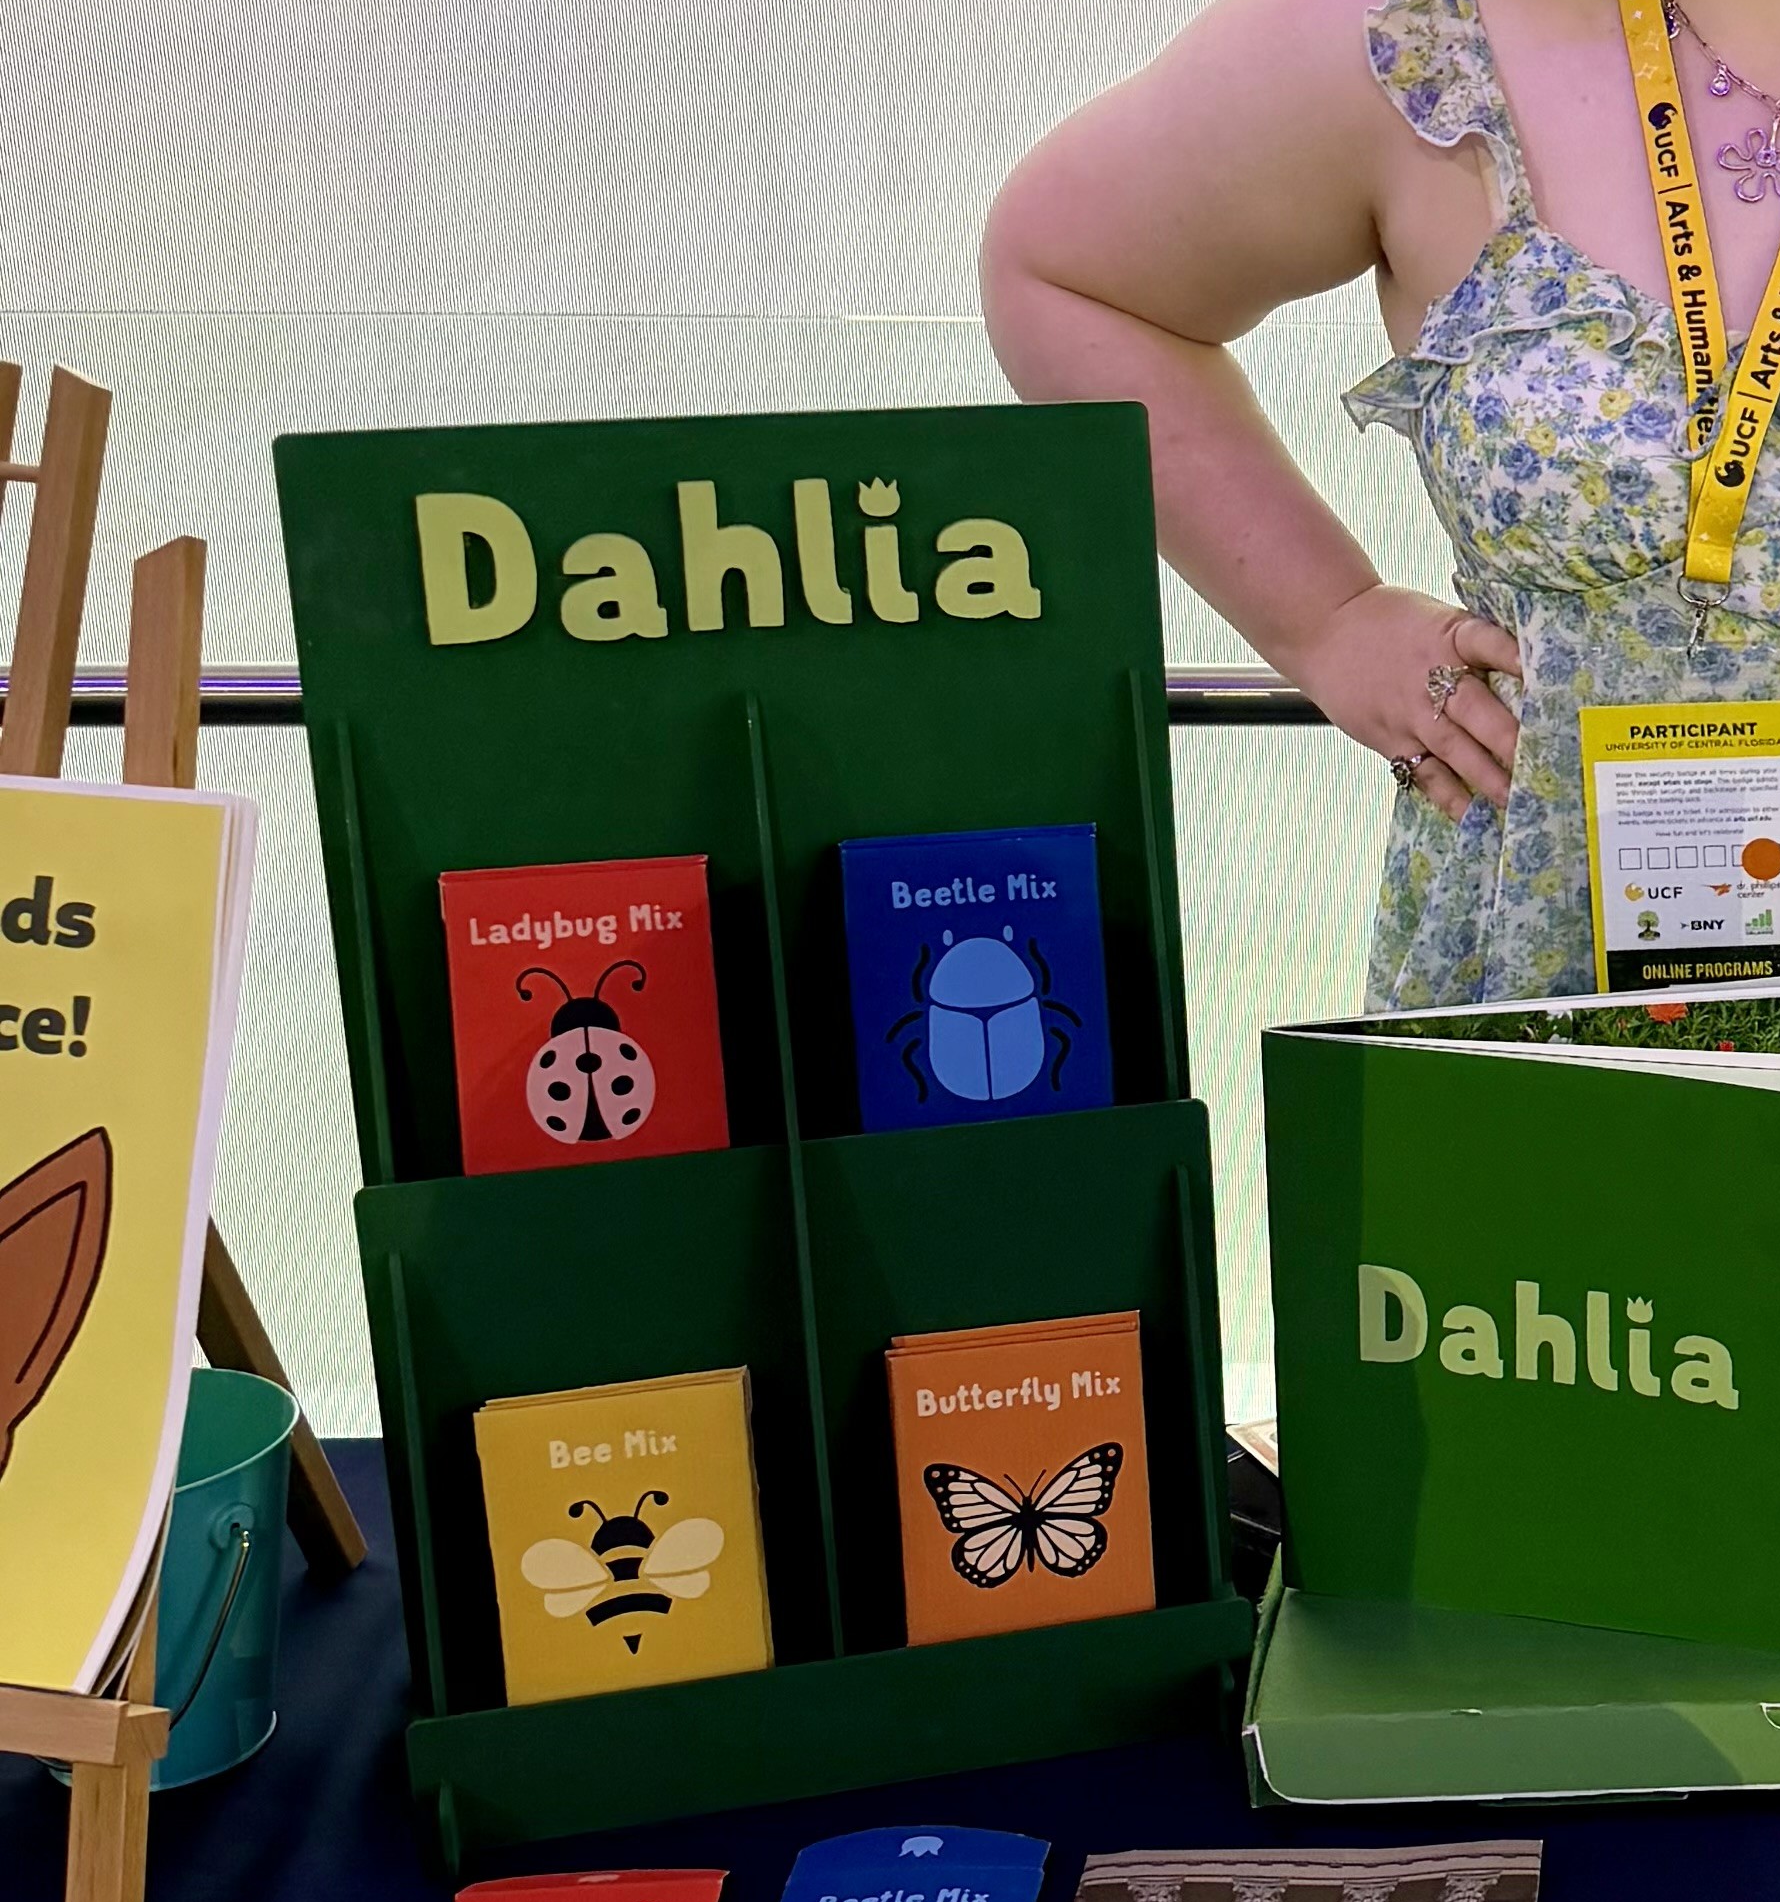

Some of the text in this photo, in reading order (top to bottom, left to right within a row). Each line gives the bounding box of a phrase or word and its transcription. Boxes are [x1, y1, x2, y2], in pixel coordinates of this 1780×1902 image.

[1654, 132, 1678, 178] UCF
[1665, 200, 1694, 257] Arts
[1677, 264, 1702, 282] &
[1730, 407, 1760, 457] UCF
[415, 476, 1042, 646] Dahlia
[1605, 741, 1667, 751] UNIVERSITY
[1670, 740, 1684, 749] OF
[1688, 739, 1734, 749] CENTRAL
[1630, 722, 1757, 739] PARTICIPANT
[891, 872, 1057, 911] Beetle Mix
[1648, 887, 1683, 899] UCF
[469, 903, 683, 948] Ladybug Mix
[1691, 919, 1725, 931] BNY
[1642, 960, 1774, 980] ONLINE PROGRAMS
[1358, 1264, 1739, 1411] Dahlia
[916, 1371, 1122, 1418] Butterfly Mix
[549, 1430, 678, 1470] Bee Mix
